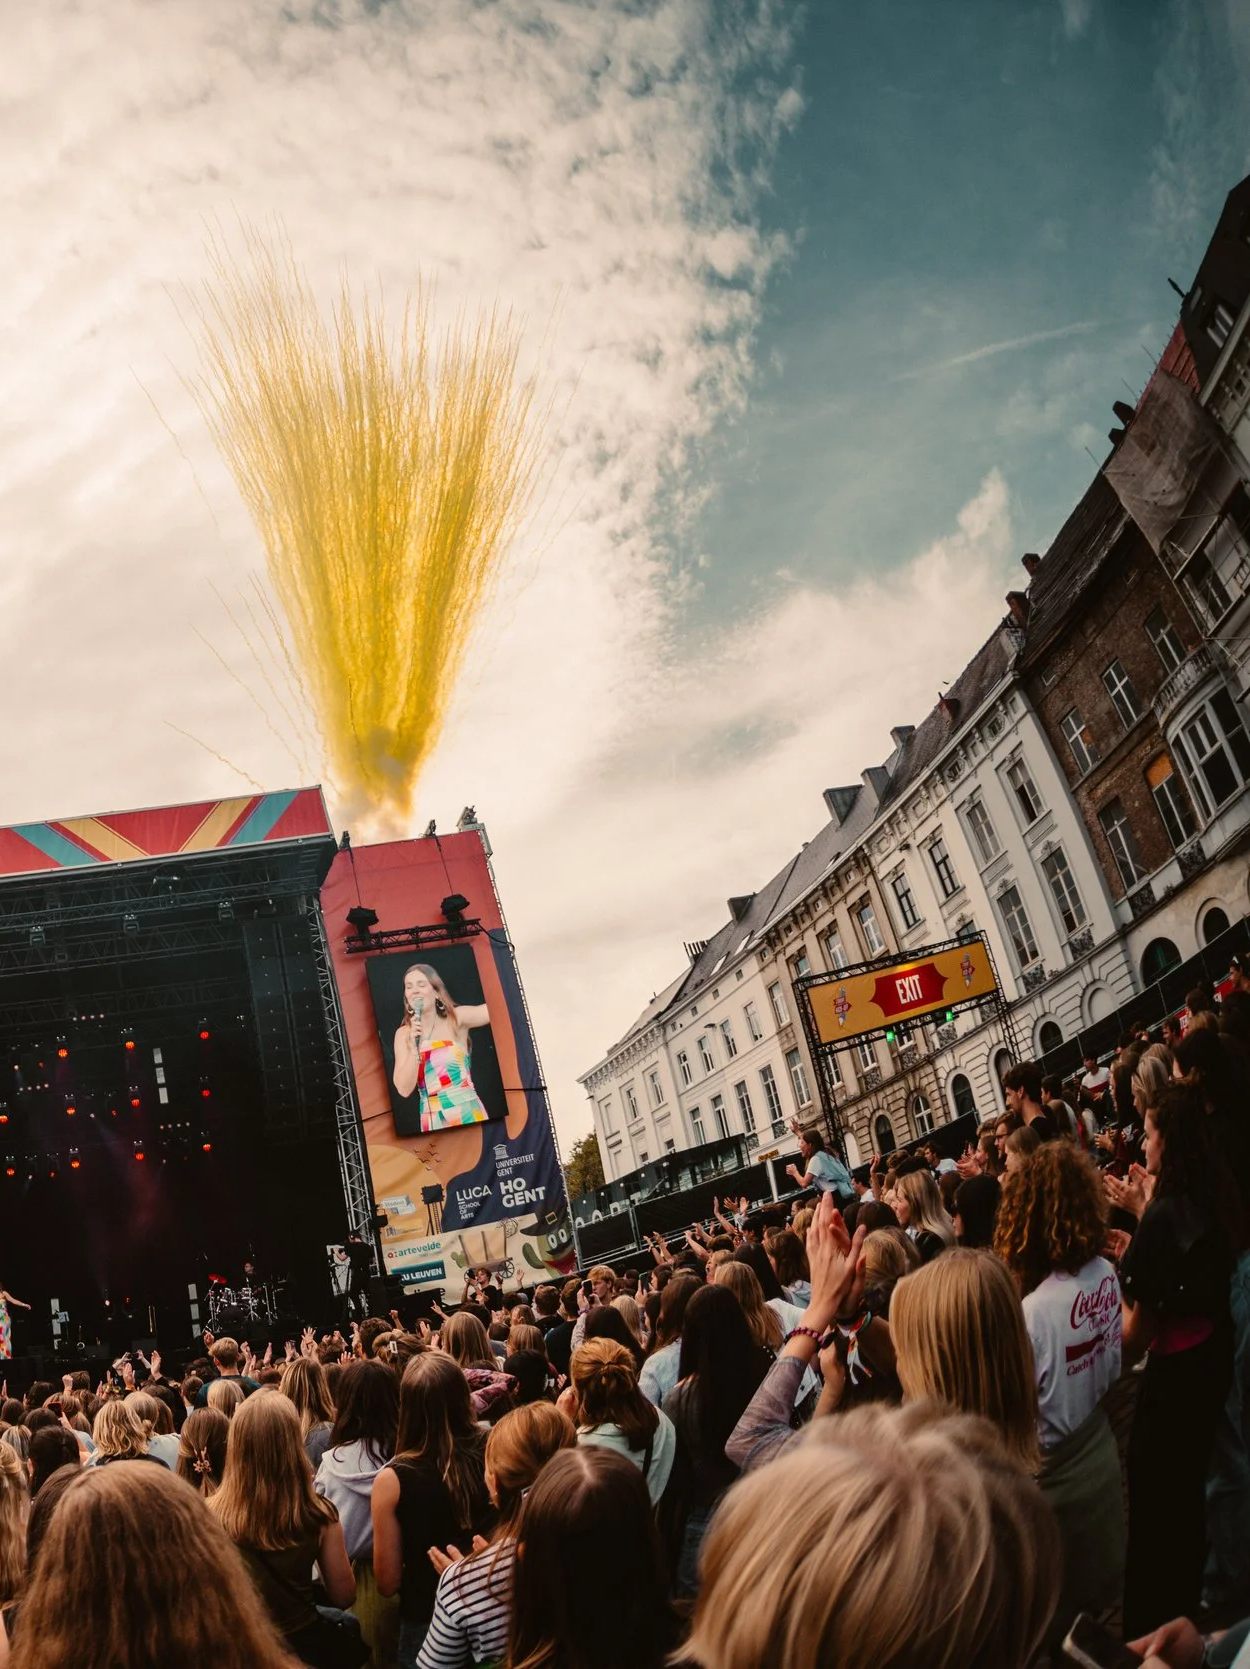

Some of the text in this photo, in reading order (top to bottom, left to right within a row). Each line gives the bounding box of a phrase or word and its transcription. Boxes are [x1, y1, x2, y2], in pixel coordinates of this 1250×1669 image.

[895, 974, 923, 1005] EXIT
[496, 1153, 535, 1169] UNIVERSITEIT
[497, 1168, 513, 1177] GENT
[500, 1177, 527, 1193] HO
[456, 1185, 492, 1202] LUCA
[502, 1186, 546, 1208] GENT
[458, 1201, 480, 1210] SCHOOL
[411, 1267, 443, 1280] LEUVEN
